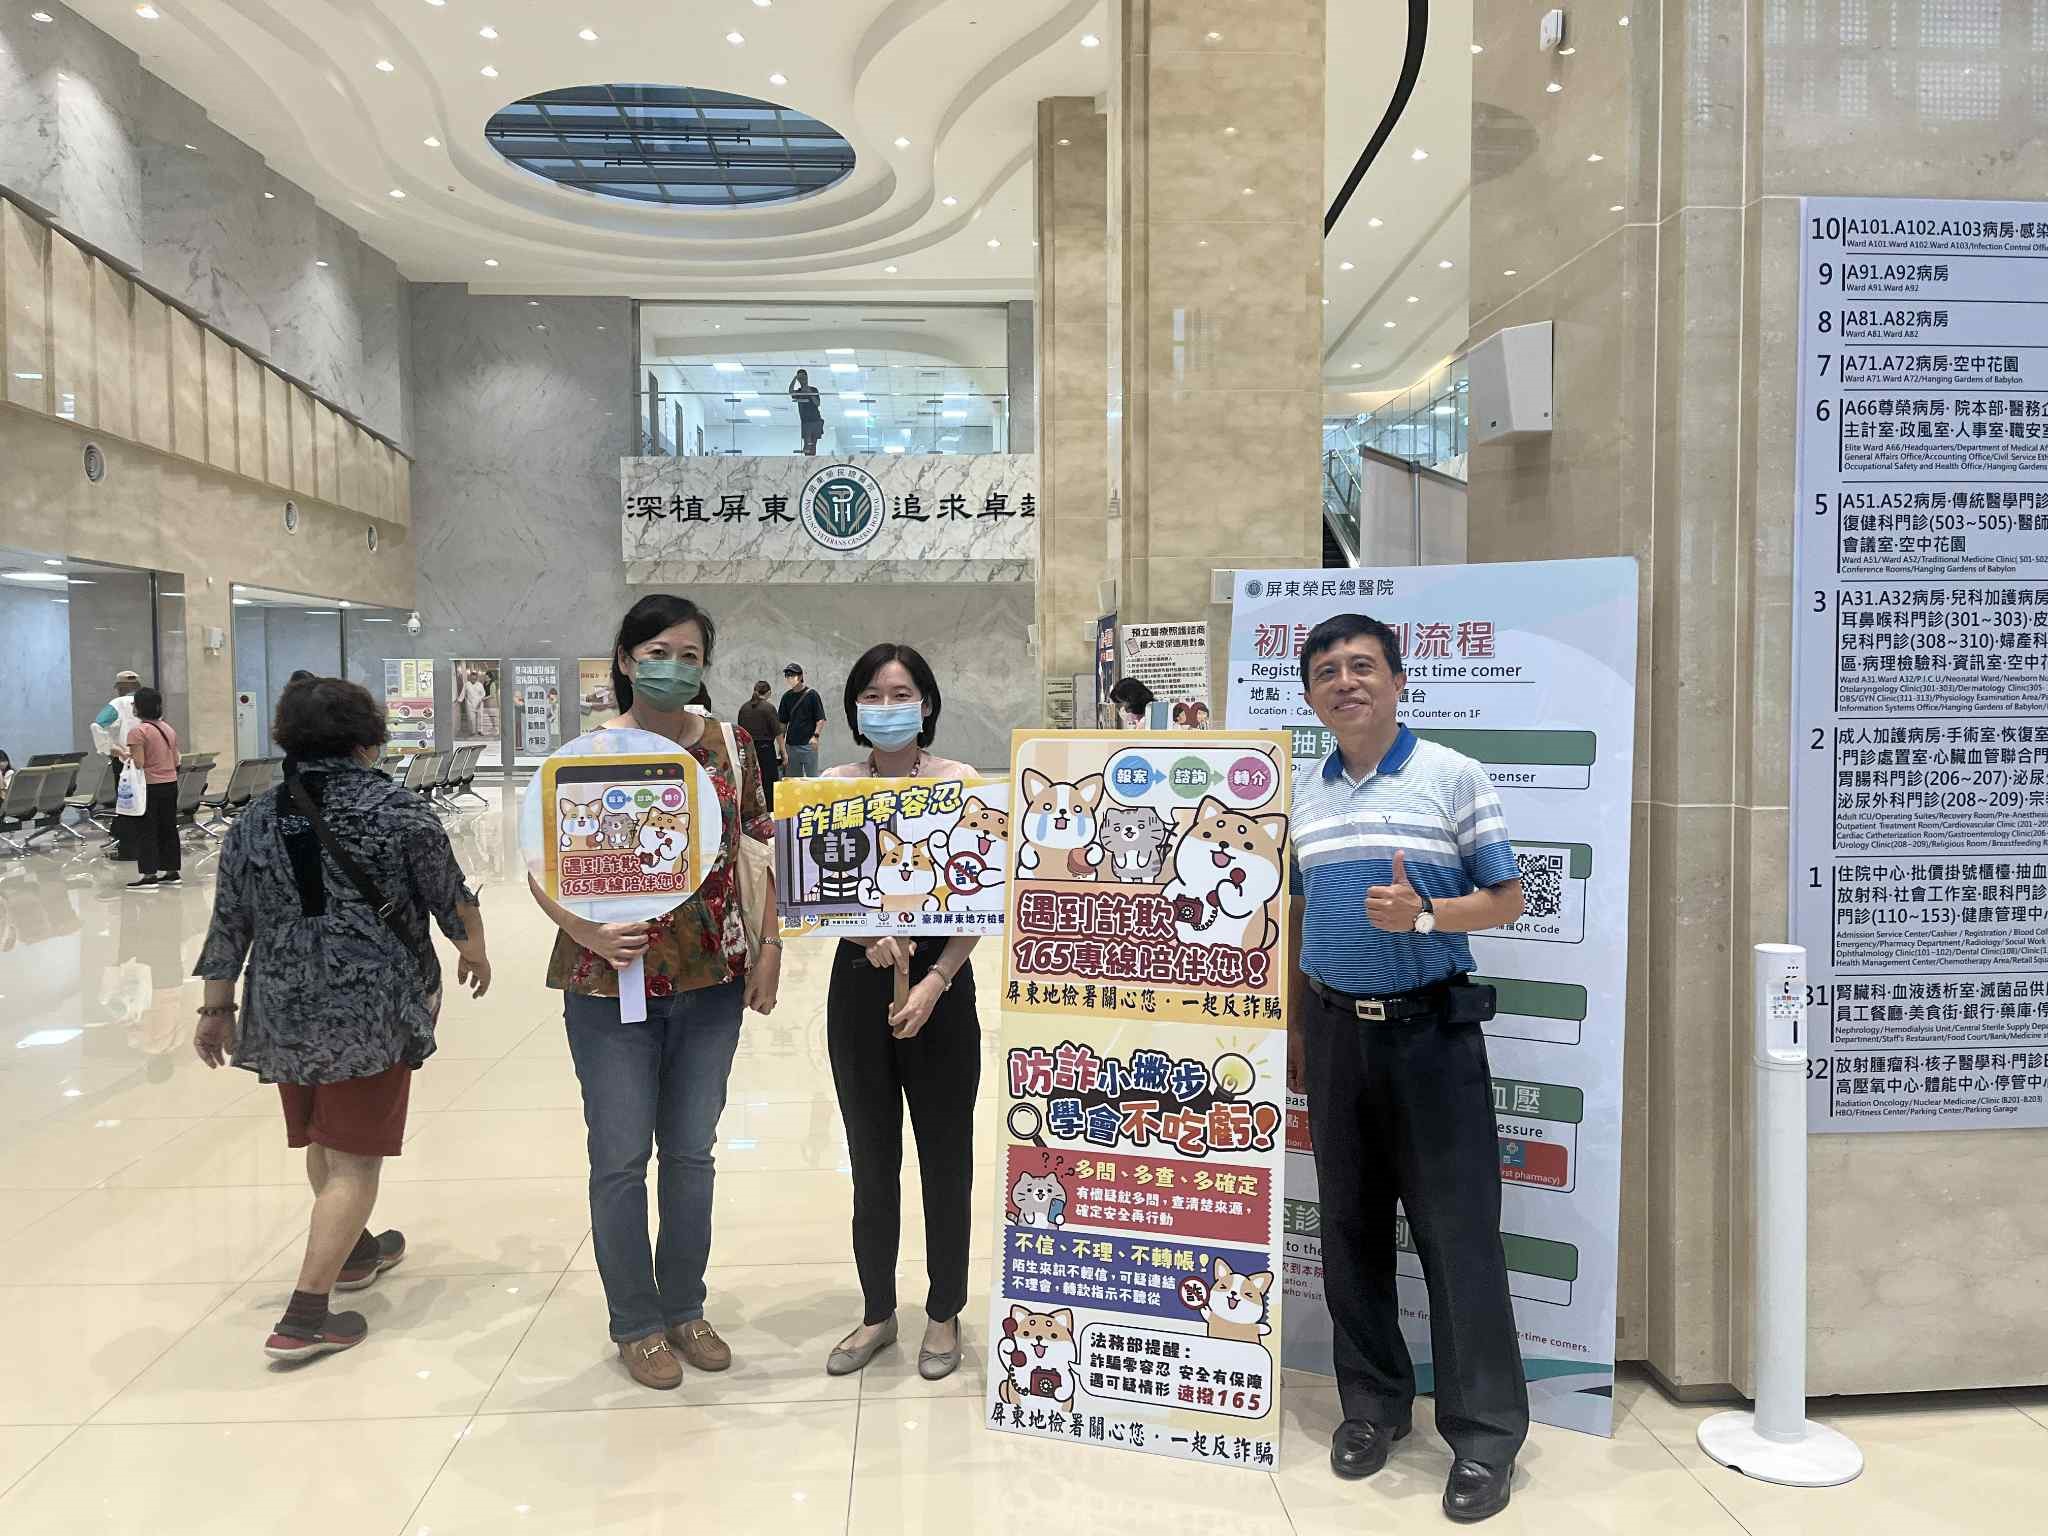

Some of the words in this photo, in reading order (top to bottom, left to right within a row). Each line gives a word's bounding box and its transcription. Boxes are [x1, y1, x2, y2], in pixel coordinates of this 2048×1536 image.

[1812, 218, 1840, 240] 10
[1847, 240, 1866, 248] Ward
[1819, 263, 1832, 285] 9
[1847, 265, 1948, 281] A91.A92病房
[1818, 311, 1831, 333] 8
[1847, 311, 1948, 327] A81.A82病房
[1817, 355, 1831, 376] 7
[1995, 376, 2023, 384] Babylon
[1816, 400, 1830, 421] 6
[1901, 453, 1966, 462] Office/Accounting
[1844, 463, 1893, 471] Occupational
[1895, 463, 1917, 471] Safety
[627, 495, 796, 523] 深植屏東
[1815, 494, 1827, 515] 5
[1843, 536, 1966, 553] 會議室·空中花園
[1842, 556, 1861, 564] Ward
[1886, 566, 1944, 574] Rooms/Hanging
[1947, 565, 1976, 573] Gardens
[1979, 565, 1985, 573] of
[1988, 565, 2016, 574] Babylon
[1266, 579, 1394, 598] 屏東榮民總醫院
[1813, 591, 1826, 612] 3
[1432, 664, 1467, 677] time
[1471, 666, 1522, 677] comer
[1840, 676, 1860, 684] Ward
[1840, 685, 1898, 694] Otolaryngology
[1249, 706, 1287, 716] Location
[1412, 709, 1451, 718] Counter
[1469, 709, 1481, 718] 1F
[1840, 704, 1883, 712] Information
[1885, 704, 1917, 712] Systems
[2006, 703, 2013, 711] of
[1811, 729, 1824, 750] 2
[1117, 769, 1148, 784] 報案
[1174, 769, 1206, 784] 諮詢
[1233, 770, 1267, 786] 轉介
[1838, 769, 2048, 787] 胃腸科門診(206~207)·泌尿
[1838, 791, 2048, 808] 泌尿外科門診(208~209)·宗
[799, 781, 963, 838] 詐騙零容忍
[1837, 822, 1876, 831] Outpatient
[825, 833, 856, 863] 詐
[564, 855, 640, 875] 遇到詐欺
[1809, 867, 1822, 888] 1
[1021, 892, 1175, 937] 遇到詐欺
[1838, 907, 2048, 925] 門診(110~153)·健康管理中
[1534, 924, 1561, 935] Code
[1837, 931, 1874, 939] Admission
[1965, 930, 2006, 938] Registration
[1836, 940, 1915, 949] Emergency/Pharmacy
[1836, 950, 1893, 958] Ophthalmology
[1863, 959, 1909, 967] Management
[1837, 982, 2048, 1000] 腎臟科·血液透析室·滅菌品供
[2007, 1024, 2029, 1032] Supply
[1010, 1042, 1207, 1100] 防詐小撇步
[1836, 1075, 2048, 1094] 高壓氧中心·體能中心·停管中
[1872, 1099, 1941, 1108] Oncology/Nuclear
[1883, 1108, 1936, 1116] Center/Parking
[1497, 1122, 1544, 1138] essure
[1076, 1159, 1258, 1196] 多問、多查、多確定
[1076, 1204, 1173, 1226] 確定安全再行動
[1287, 1241, 1299, 1252] to
[1550, 1337, 1591, 1354] comers.
[1090, 1353, 1170, 1377] 詐騙零容忍
[1179, 1365, 1263, 1390] 安全有保障
[1090, 1373, 1170, 1396] 遇可疑情形
[1178, 1384, 1260, 1411] 速撥165
